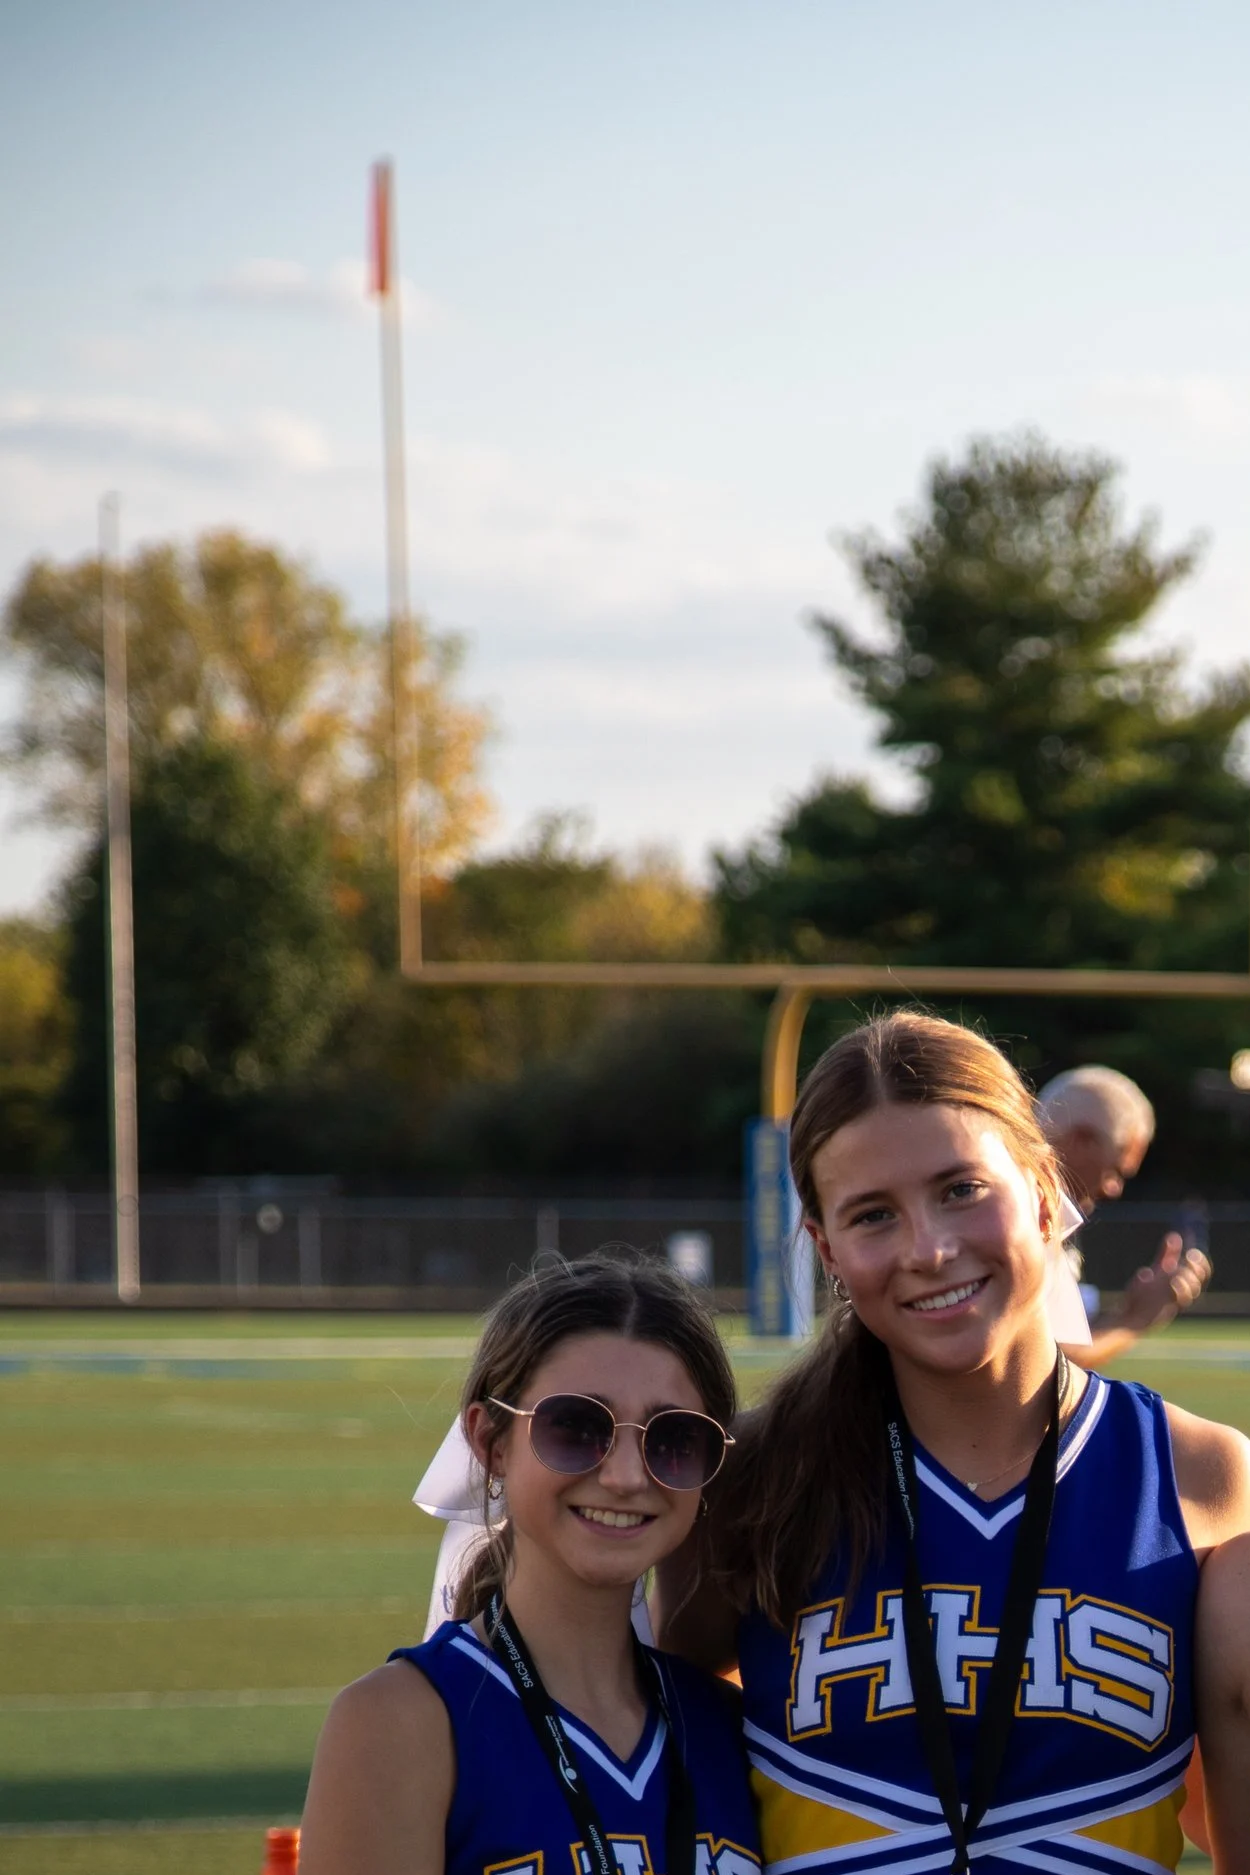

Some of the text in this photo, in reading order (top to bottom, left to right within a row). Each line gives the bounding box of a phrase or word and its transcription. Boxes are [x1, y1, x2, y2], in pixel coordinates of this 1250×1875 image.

[887, 1422, 901, 1449] SACS
[893, 1450, 907, 1492] Education
[498, 1620, 521, 1661] Education
[514, 1660, 535, 1688] SACS
[786, 1583, 1174, 1752] HHS
[588, 1824, 611, 1874] Foundation
